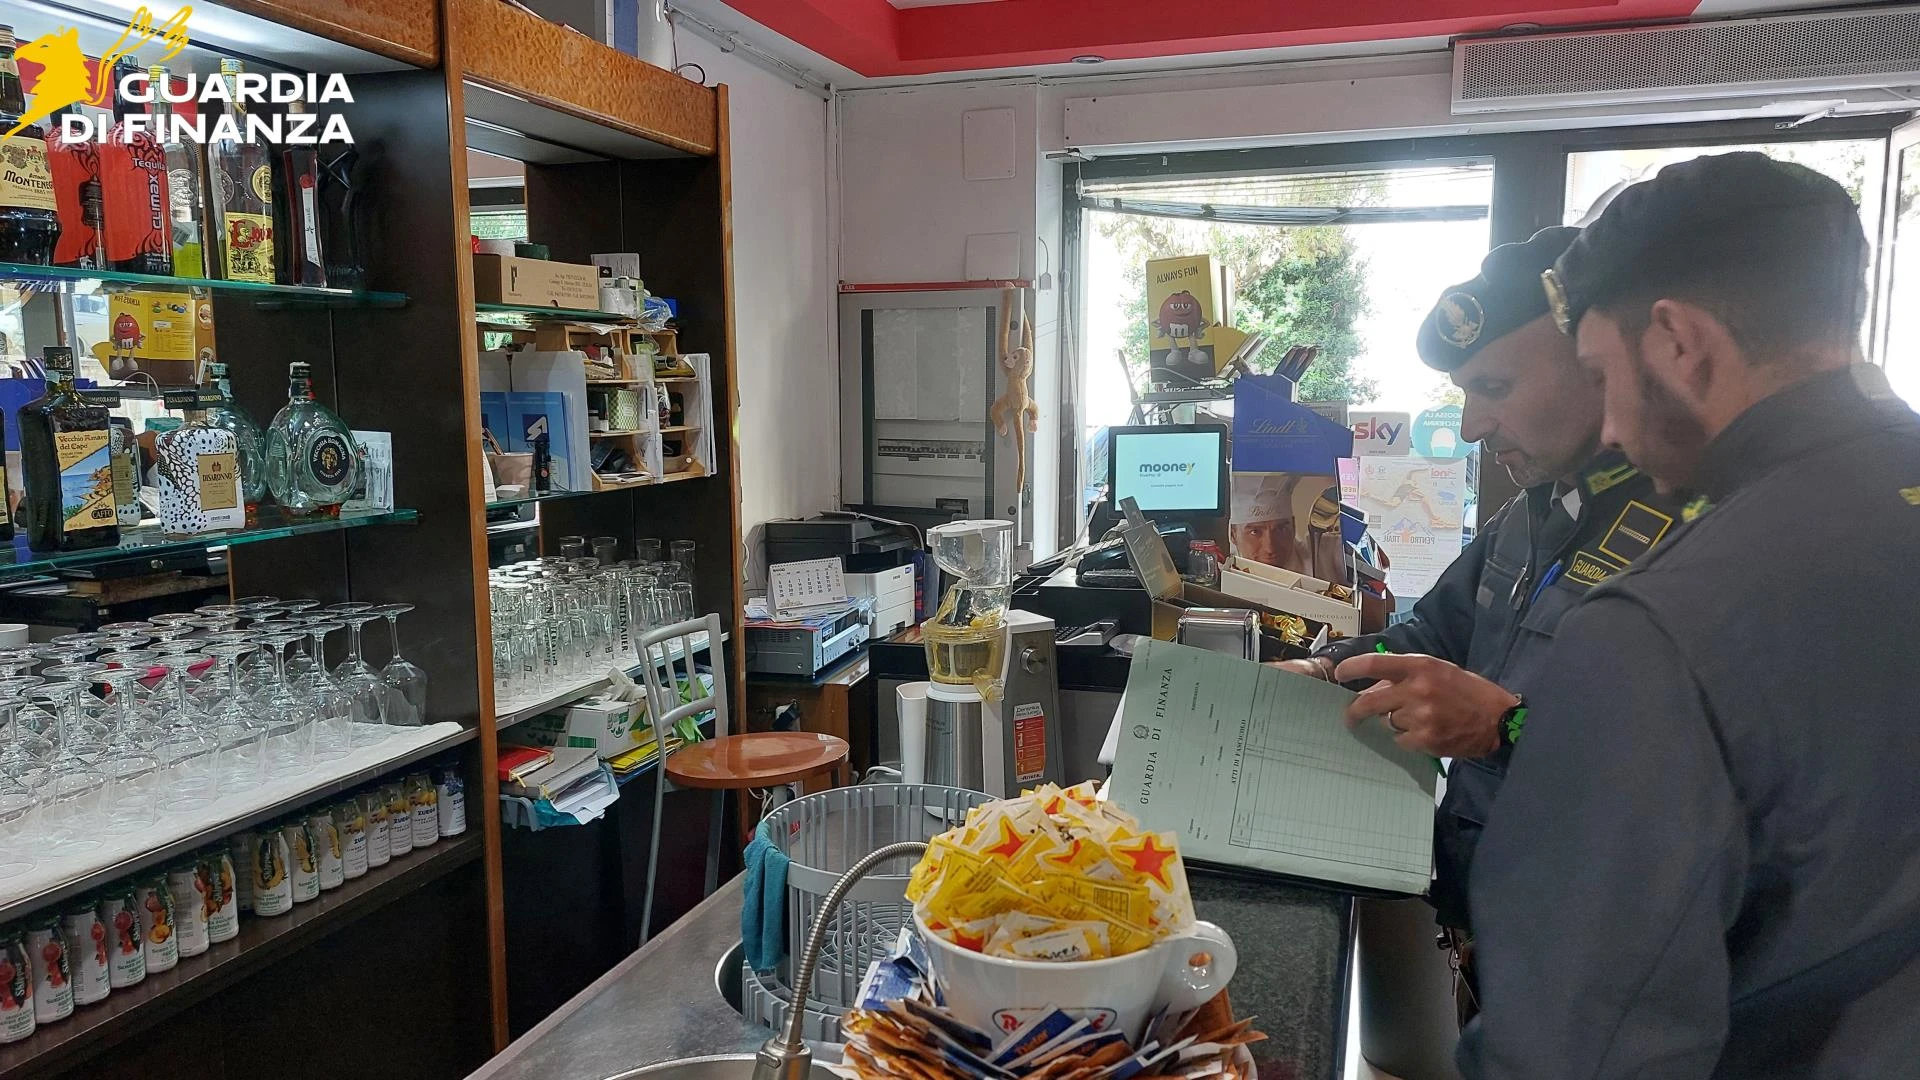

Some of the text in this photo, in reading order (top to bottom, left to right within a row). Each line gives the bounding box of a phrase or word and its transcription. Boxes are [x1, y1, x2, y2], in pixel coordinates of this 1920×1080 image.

[132, 157, 167, 171] Tequila
[4, 170, 53, 190] MONTENEG
[1156, 265, 1199, 284] ALWAYS FUN
[1248, 418, 1297, 434] Lindt
[1354, 416, 1403, 446] sky
[202, 473, 233, 482] DISARONNO
[1139, 462, 1196, 475] mooney
[92, 509, 113, 519] CAFFO
[1573, 559, 1608, 583] GUARDIA
[619, 594, 629, 652] NITTENAUER
[1139, 667, 1173, 805] GUARDIA DI FINANZA
